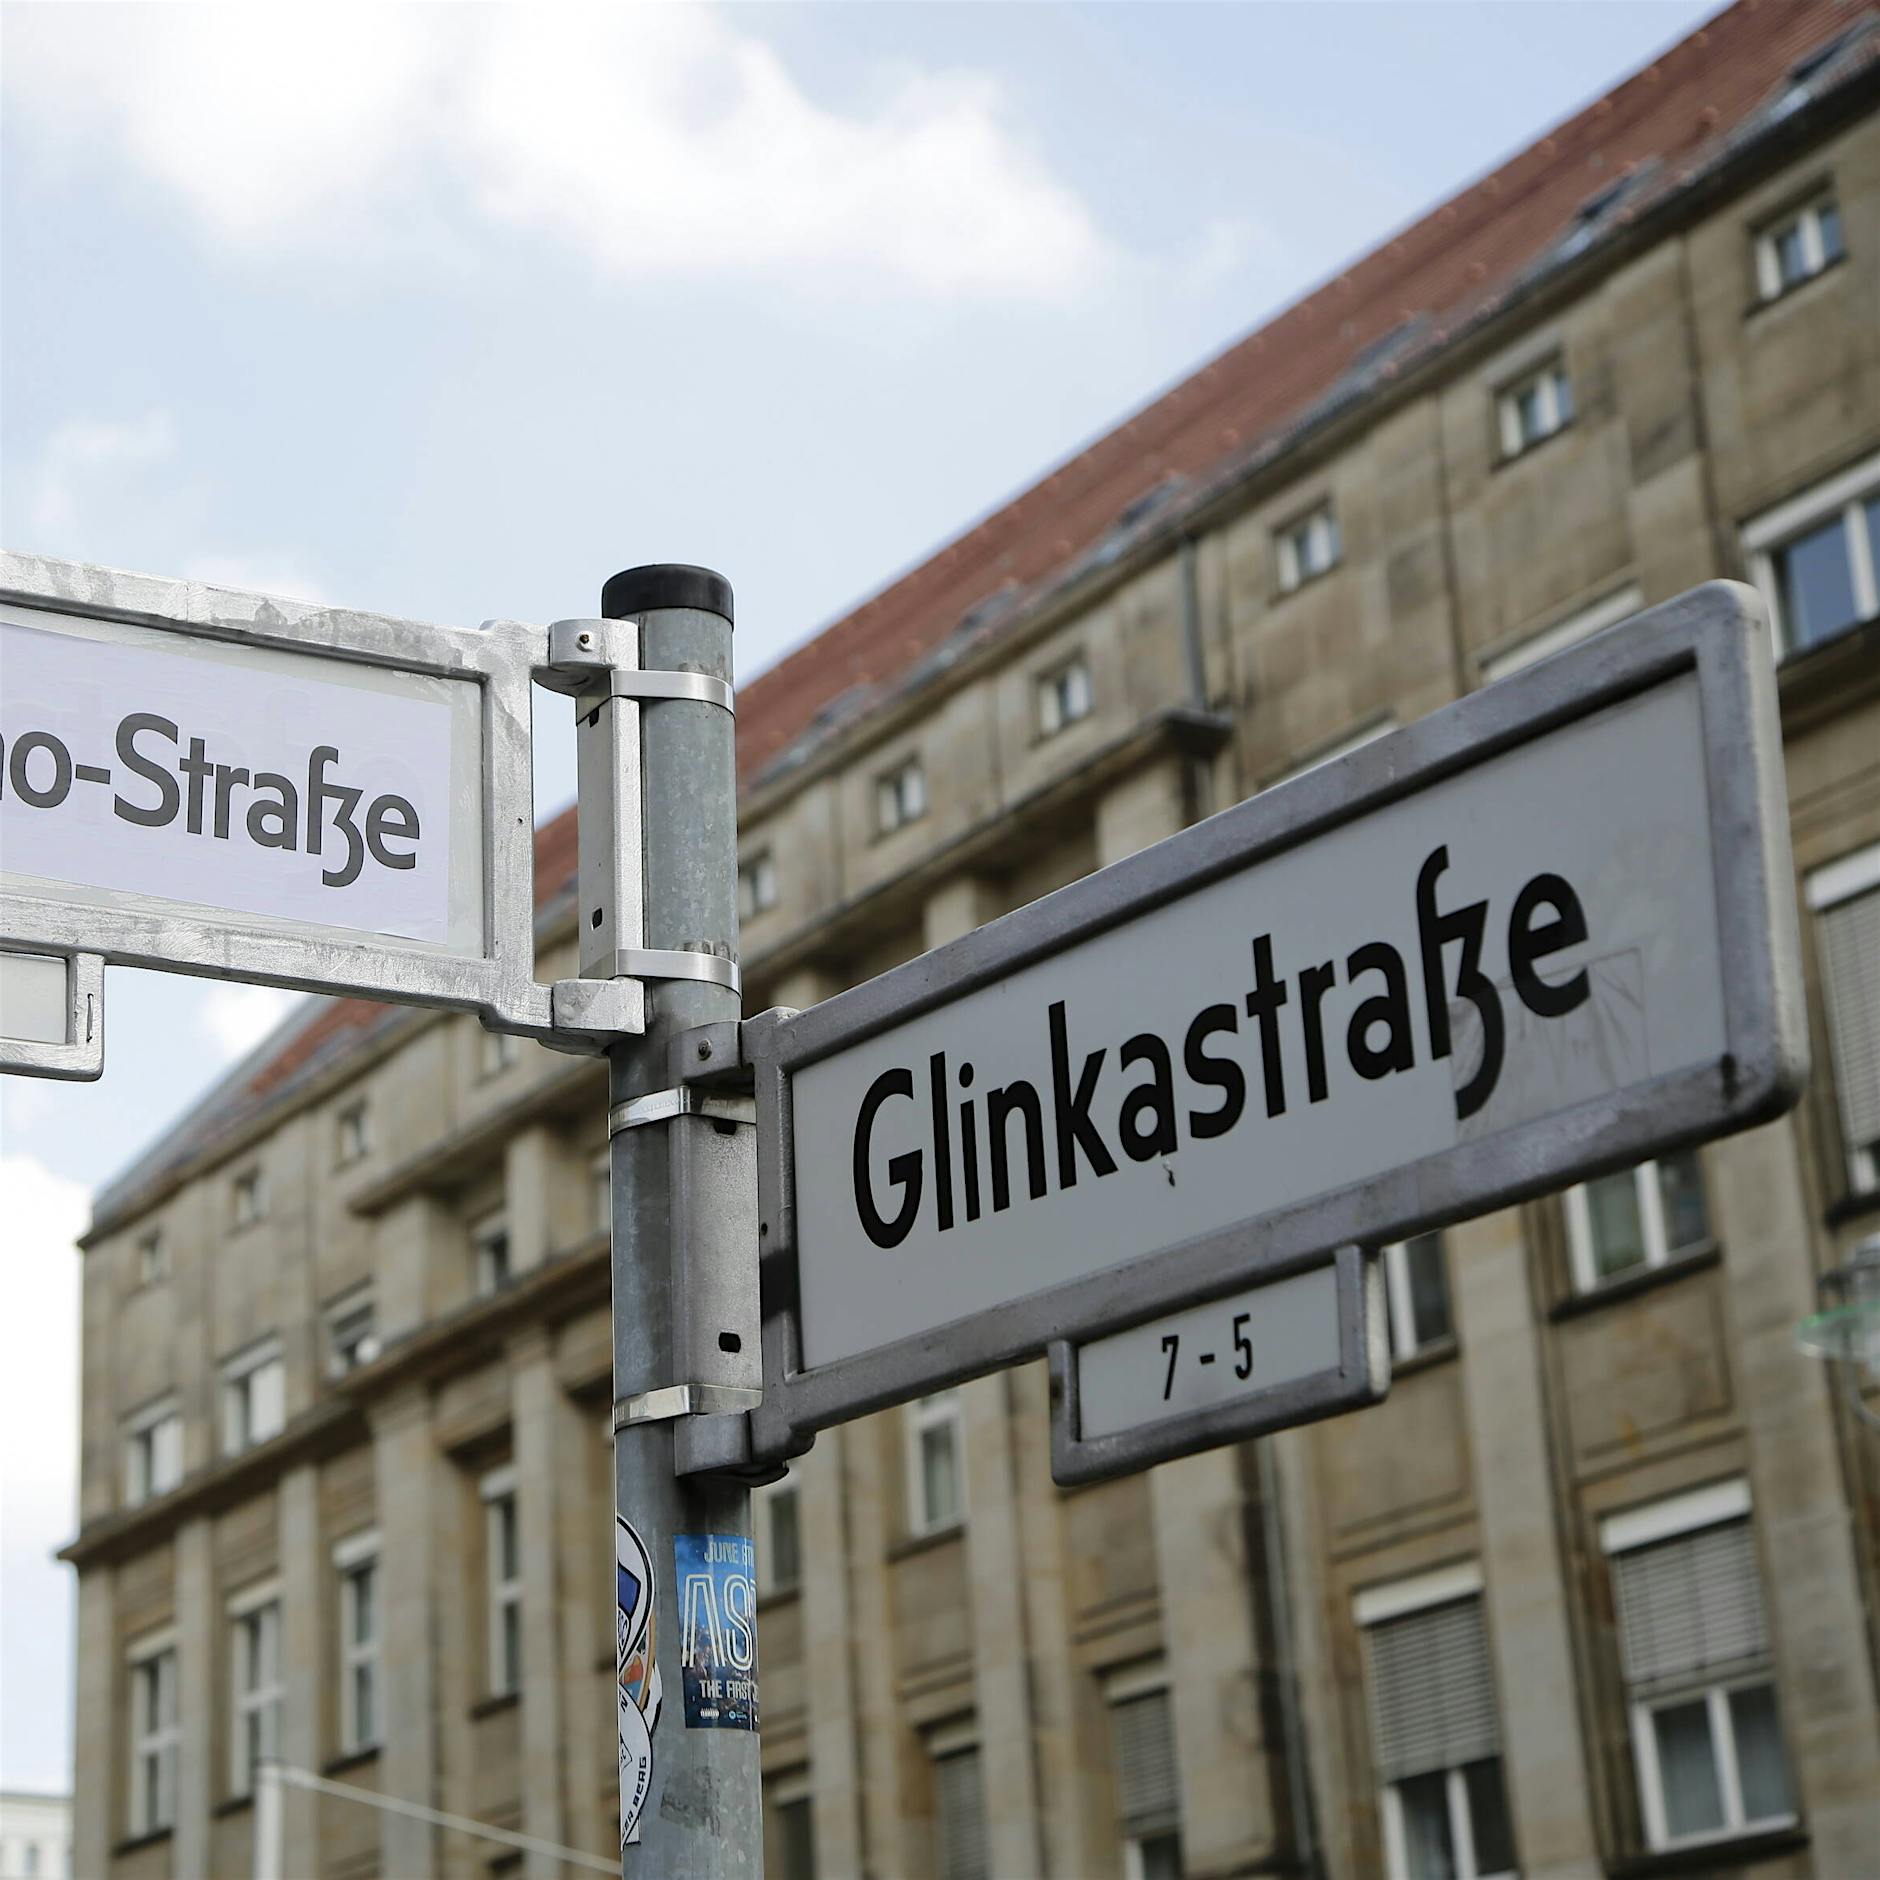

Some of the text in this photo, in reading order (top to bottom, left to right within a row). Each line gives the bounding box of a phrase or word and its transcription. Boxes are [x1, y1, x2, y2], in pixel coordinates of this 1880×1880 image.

[0, 713, 420, 888] o-Straße
[852, 844, 1590, 1250] Glinkastraße
[1162, 1334, 1179, 1400] 7
[1233, 1312, 1253, 1380] 5
[704, 1541, 738, 1564] JUNE
[699, 1679, 723, 1698] THE
